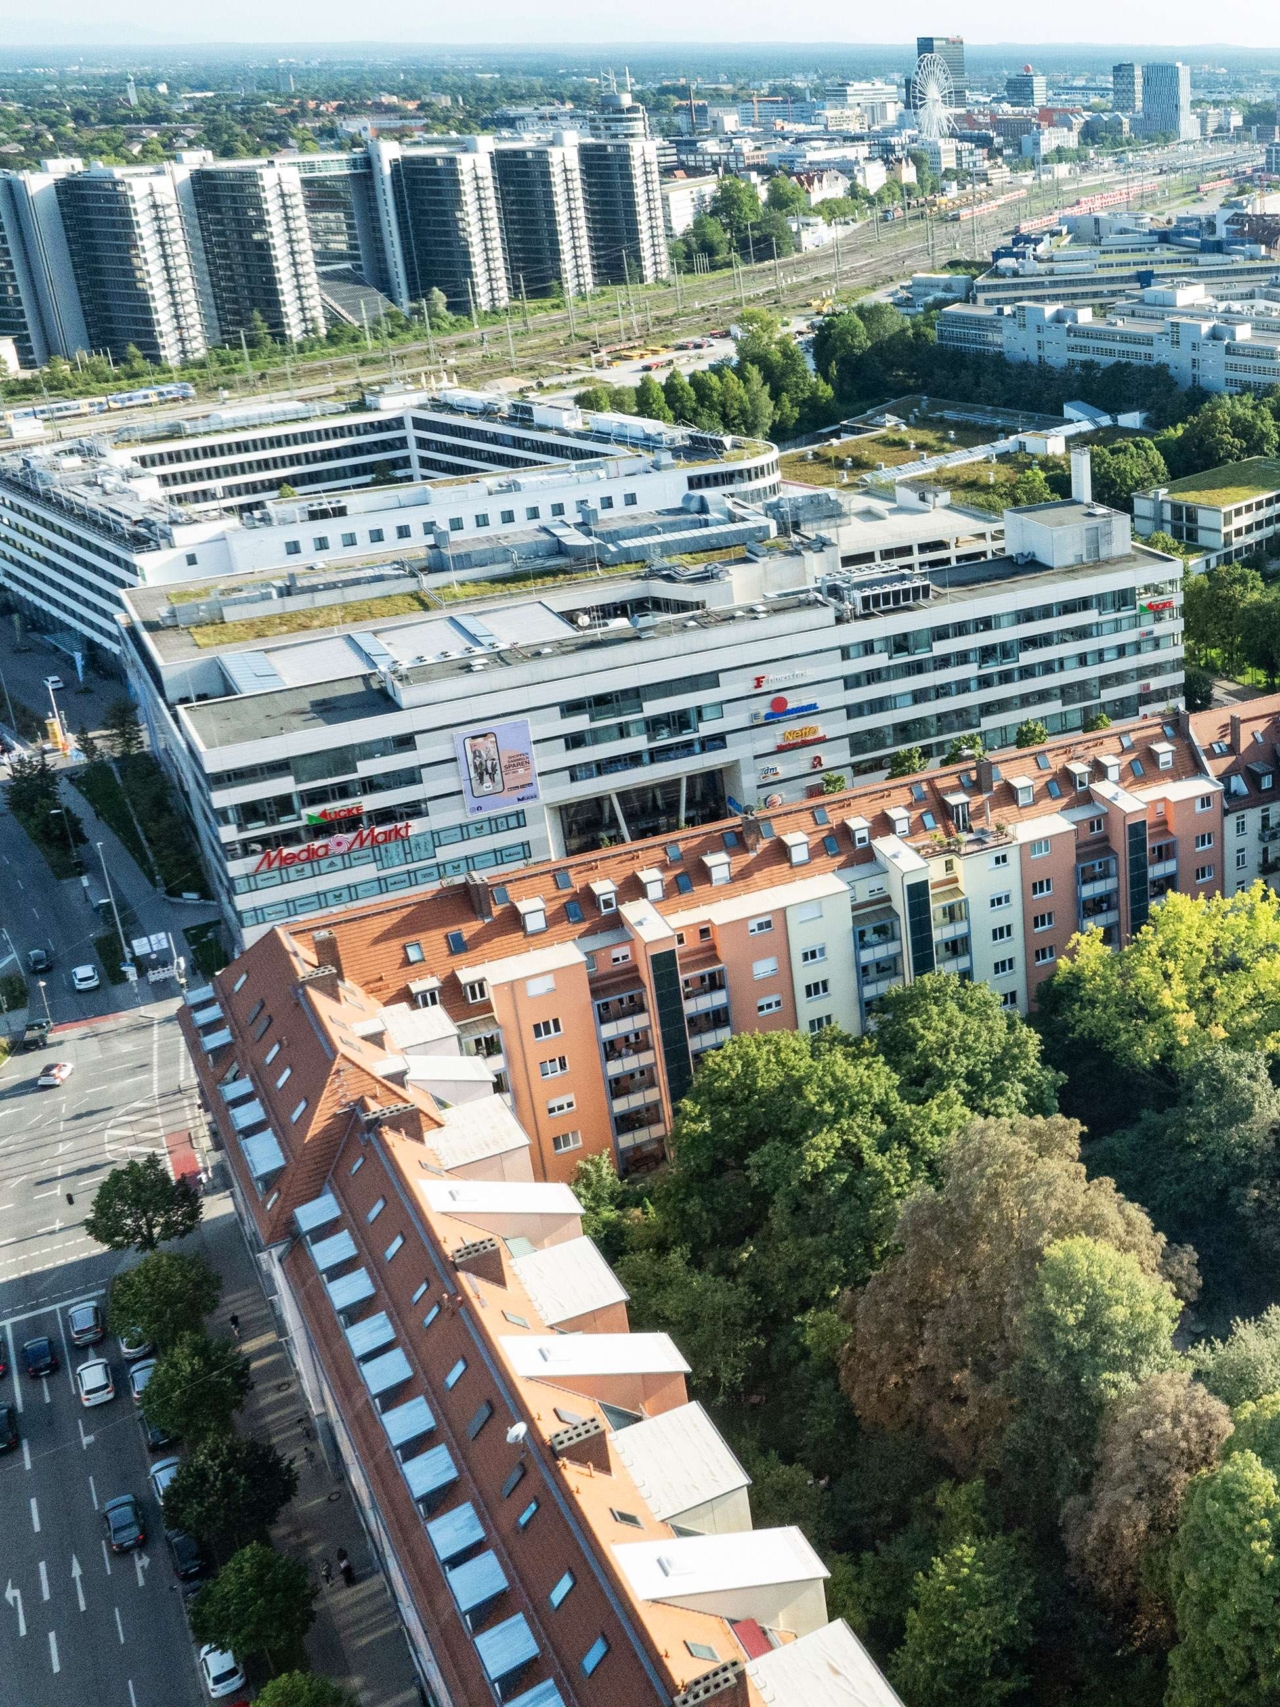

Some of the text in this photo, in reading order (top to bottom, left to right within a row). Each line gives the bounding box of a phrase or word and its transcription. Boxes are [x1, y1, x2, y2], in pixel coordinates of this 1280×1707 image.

[784, 726, 819, 741] Netto
[503, 760, 530, 770] SPAREN
[763, 766, 777, 775] dm
[254, 822, 412, 873] Media Markt
